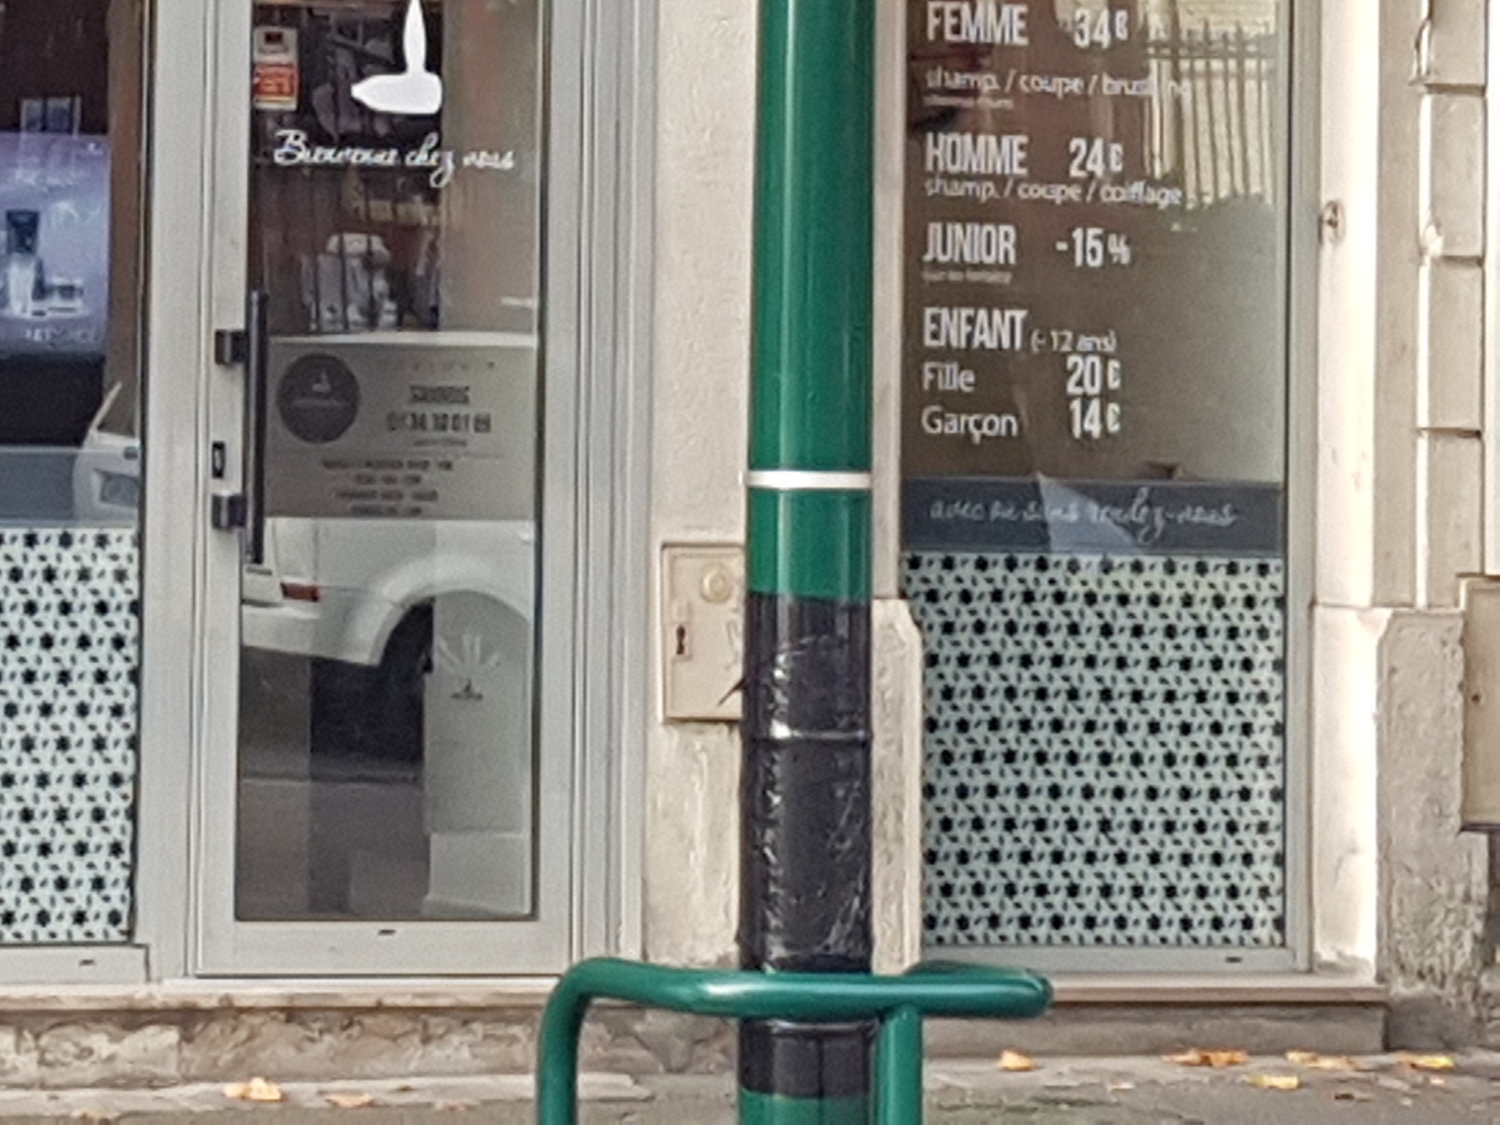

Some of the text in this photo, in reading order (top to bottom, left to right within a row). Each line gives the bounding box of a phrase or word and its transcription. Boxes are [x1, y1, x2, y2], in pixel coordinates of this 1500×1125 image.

[926, 0, 1029, 46] FEMME
[1019, 74, 1086, 100] coupe
[1102, 72, 1192, 102] brusng
[405, 132, 455, 188] chez
[925, 133, 1028, 176] HOMME
[1017, 182, 1083, 205] coupe
[922, 222, 1017, 265] JUNIOR
[922, 307, 1028, 350] ENFANT
[922, 361, 976, 392] Fille
[921, 405, 1018, 445] Garçon
